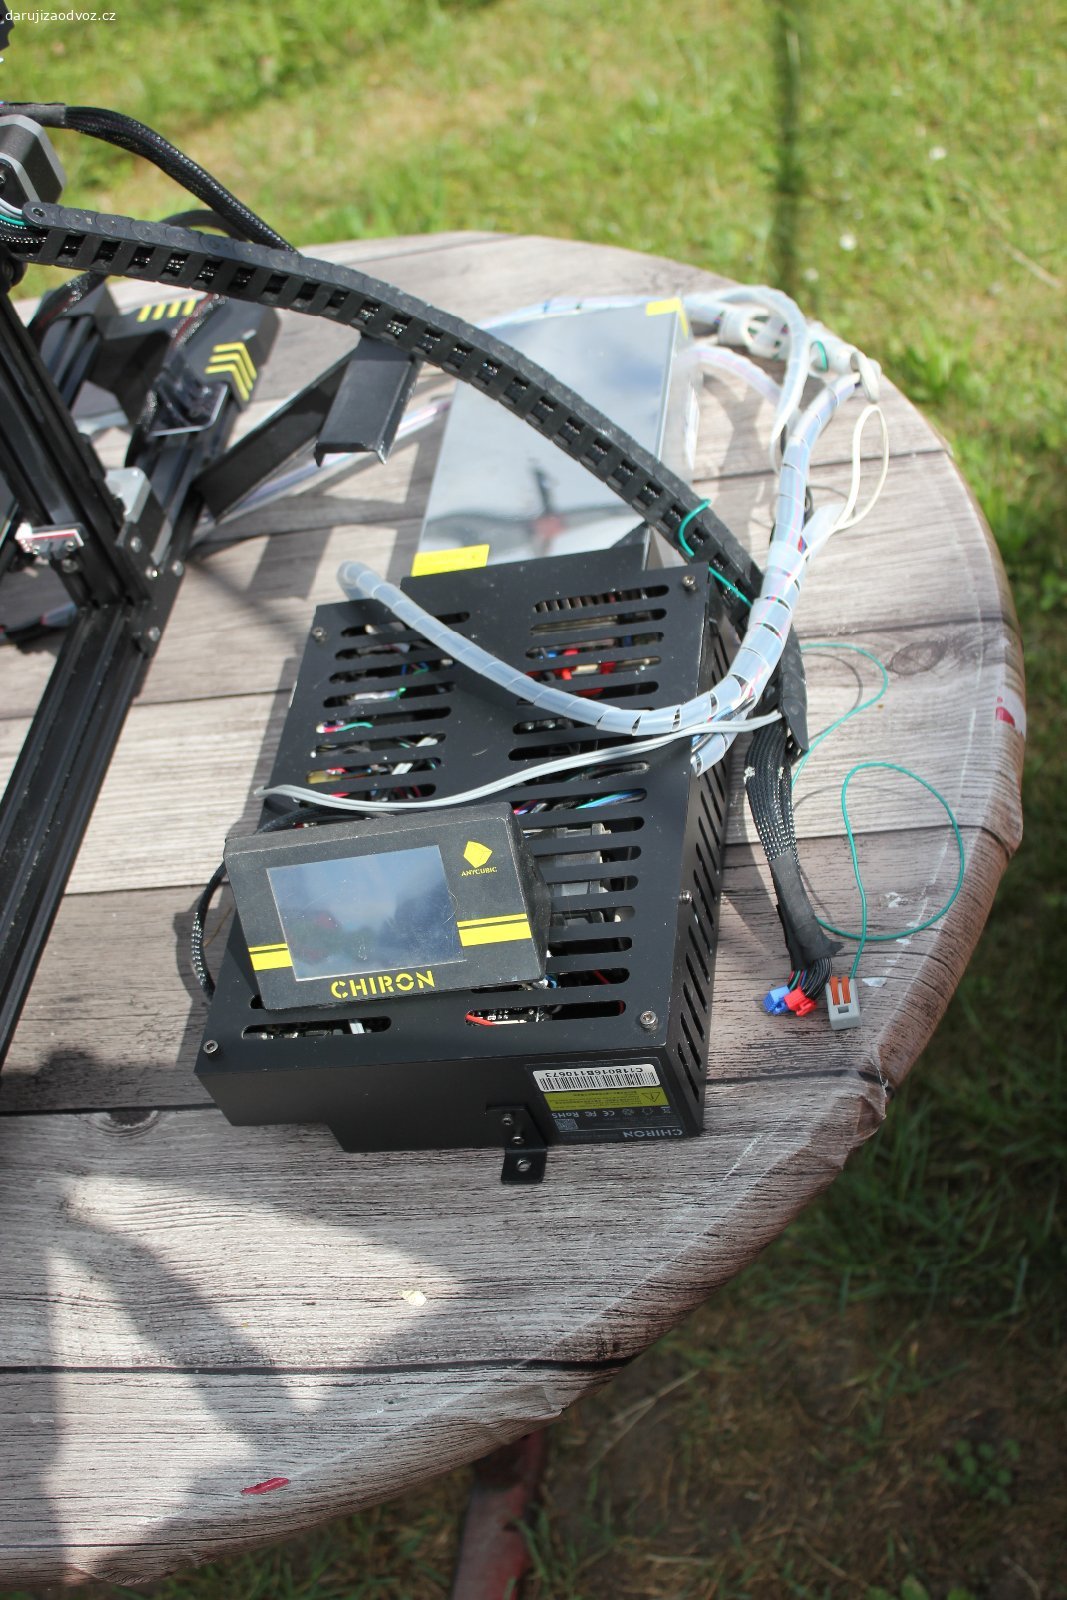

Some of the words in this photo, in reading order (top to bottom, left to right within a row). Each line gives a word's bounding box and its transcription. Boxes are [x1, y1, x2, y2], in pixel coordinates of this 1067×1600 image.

[461, 866, 498, 877] ANYCUBIC
[330, 970, 435, 999] CHIRON
[551, 1110, 580, 1119] RoHS
[622, 1128, 683, 1138] CHIRON
